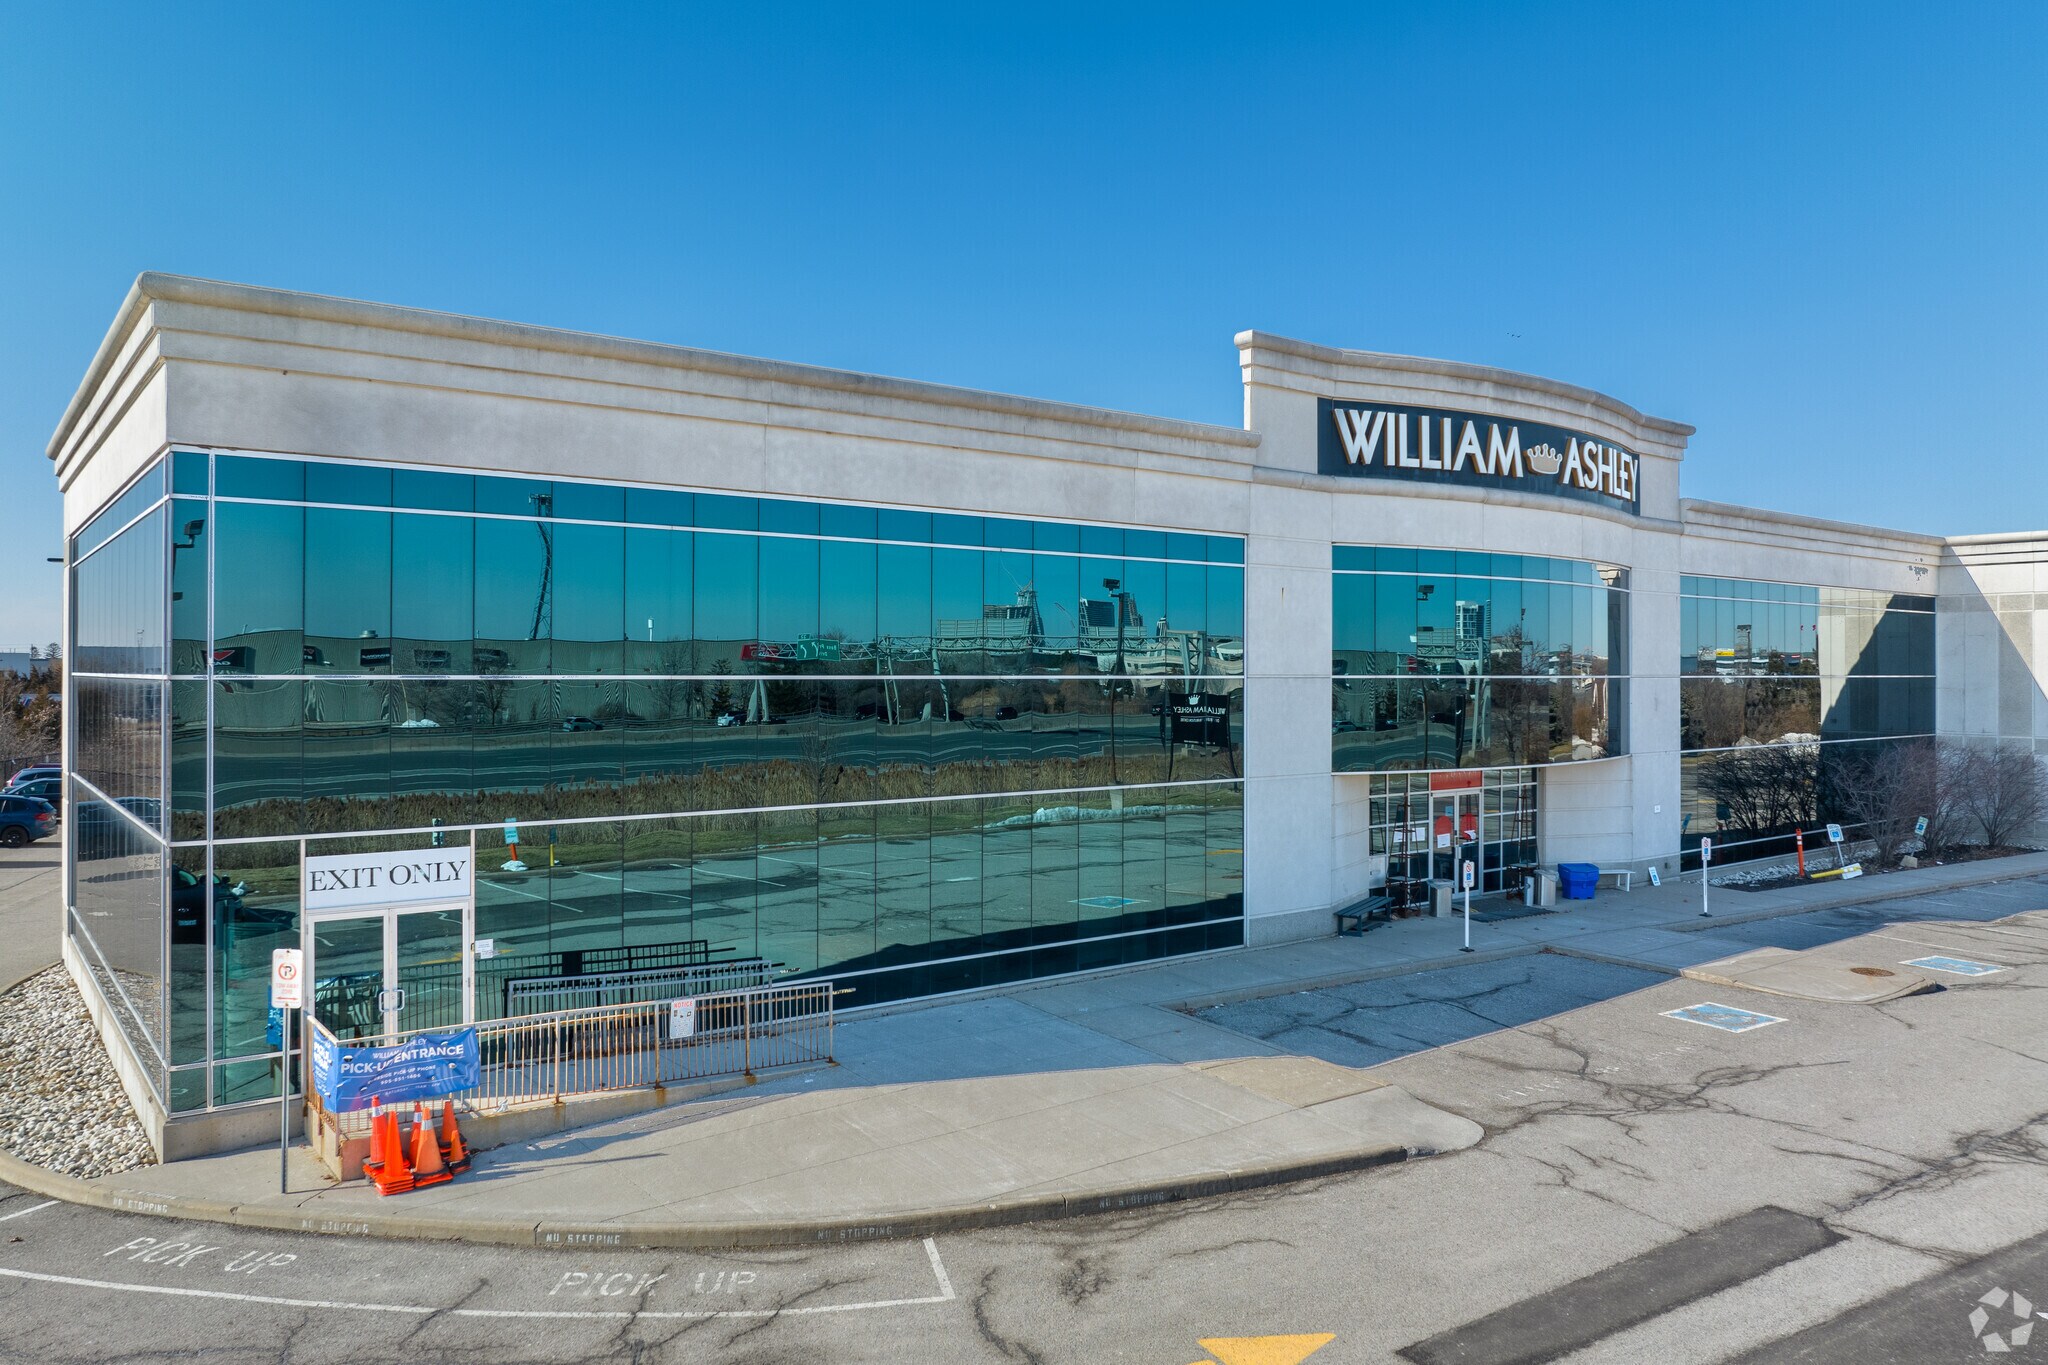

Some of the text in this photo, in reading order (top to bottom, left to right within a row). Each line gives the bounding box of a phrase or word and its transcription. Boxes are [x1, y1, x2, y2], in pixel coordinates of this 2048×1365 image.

[1333, 408, 1639, 502] WILLIAM ASHLEY
[309, 860, 467, 892] EXIT ONLY
[393, 1044, 464, 1063] ENTRANCE
[103, 1236, 298, 1275] PICK UP
[549, 1271, 757, 1297] PICK UP
